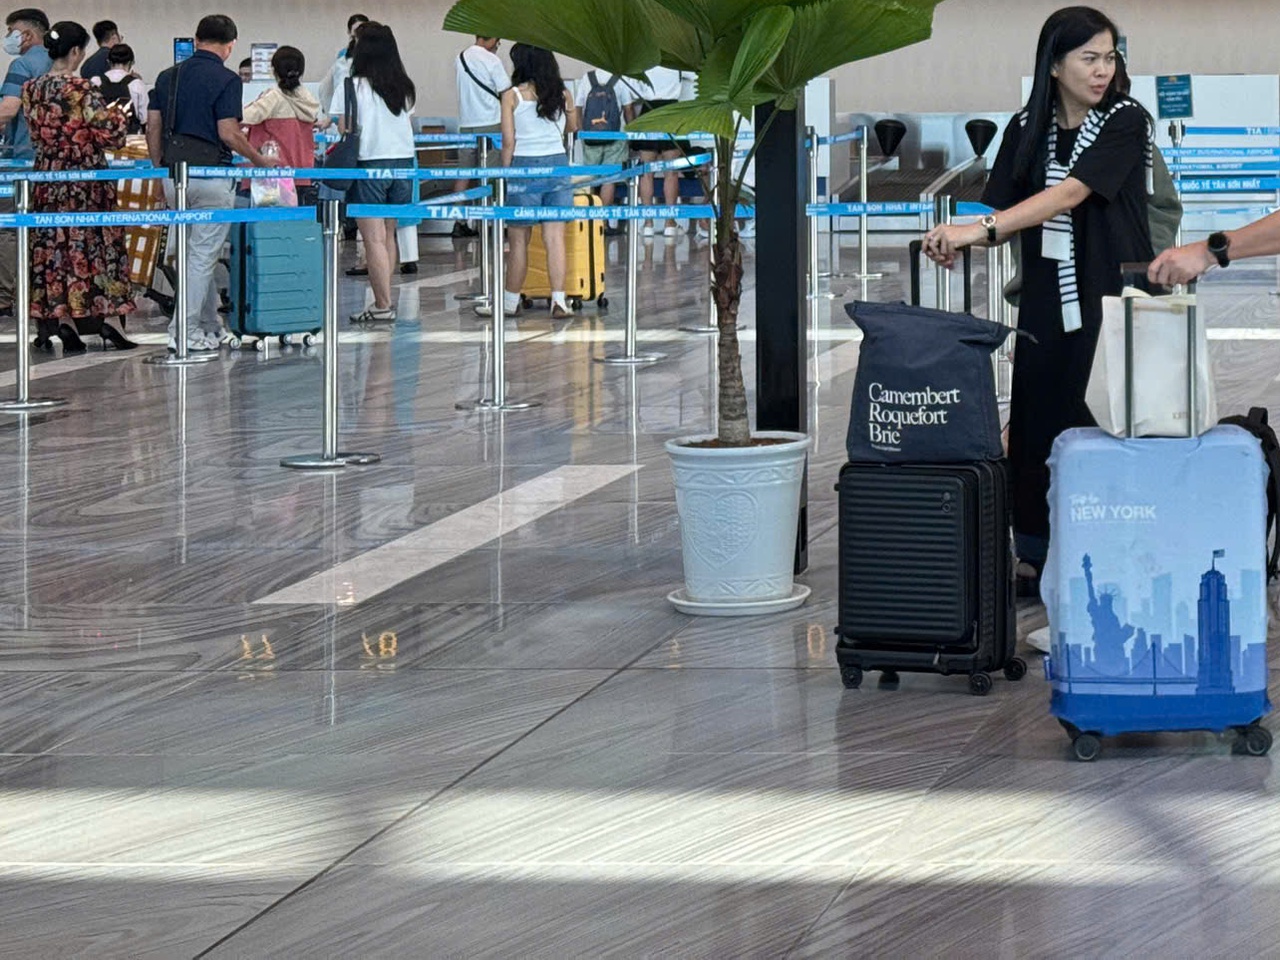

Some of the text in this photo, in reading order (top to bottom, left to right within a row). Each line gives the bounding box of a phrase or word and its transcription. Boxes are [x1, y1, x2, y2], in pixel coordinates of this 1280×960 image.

[366, 169, 393, 179] TIA
[478, 168, 525, 176] INTERNATIONAL
[527, 167, 554, 175] AIRPORT
[35, 211, 214, 225] TAN SON NHAT INTERNATIONAL AIRPORT
[426, 206, 464, 219] TIA
[868, 382, 961, 406] Camembert
[868, 402, 948, 430] Roquefort
[869, 422, 902, 445] Brie
[1070, 504, 1157, 522] NEW YORK
